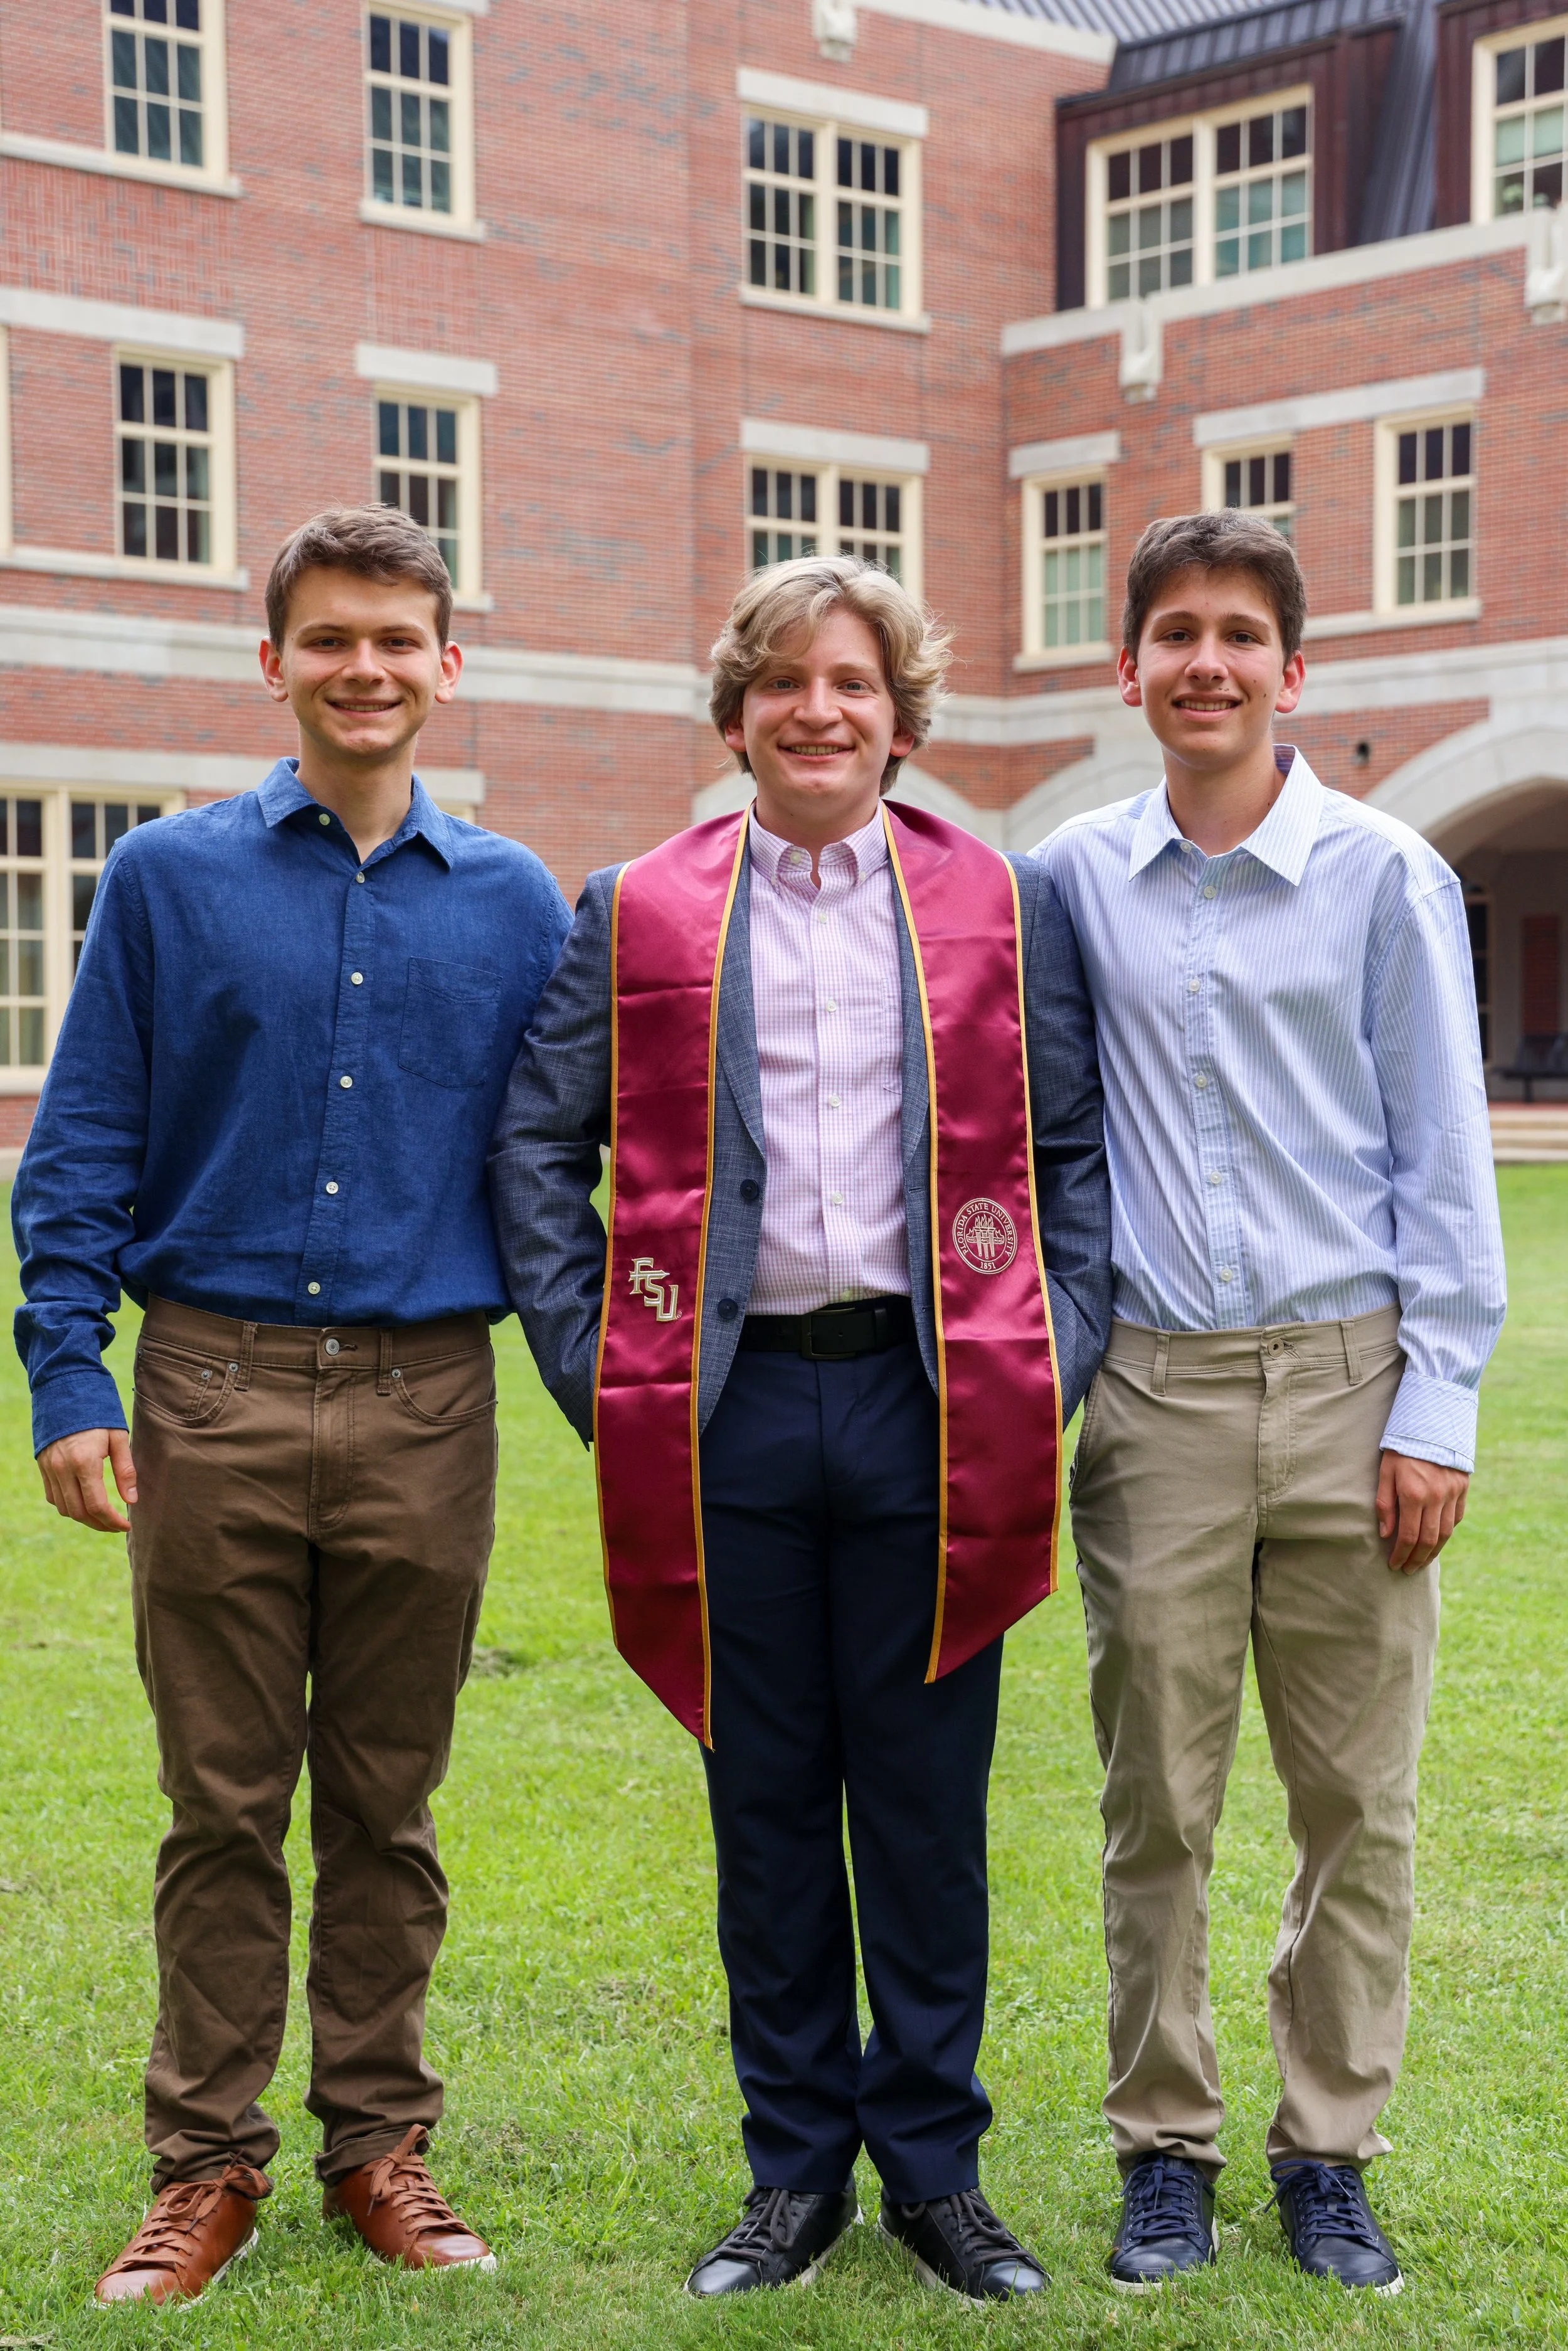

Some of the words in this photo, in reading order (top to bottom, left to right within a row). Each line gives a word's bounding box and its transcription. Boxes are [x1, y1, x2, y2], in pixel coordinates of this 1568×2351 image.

[957, 1215, 968, 1256] FLORIDA
[967, 1202, 989, 1214] STATE
[992, 1206, 1014, 1256] UNIVERSITY
[628, 1257, 679, 1322] FSU
[980, 1261, 996, 1270] 1851
